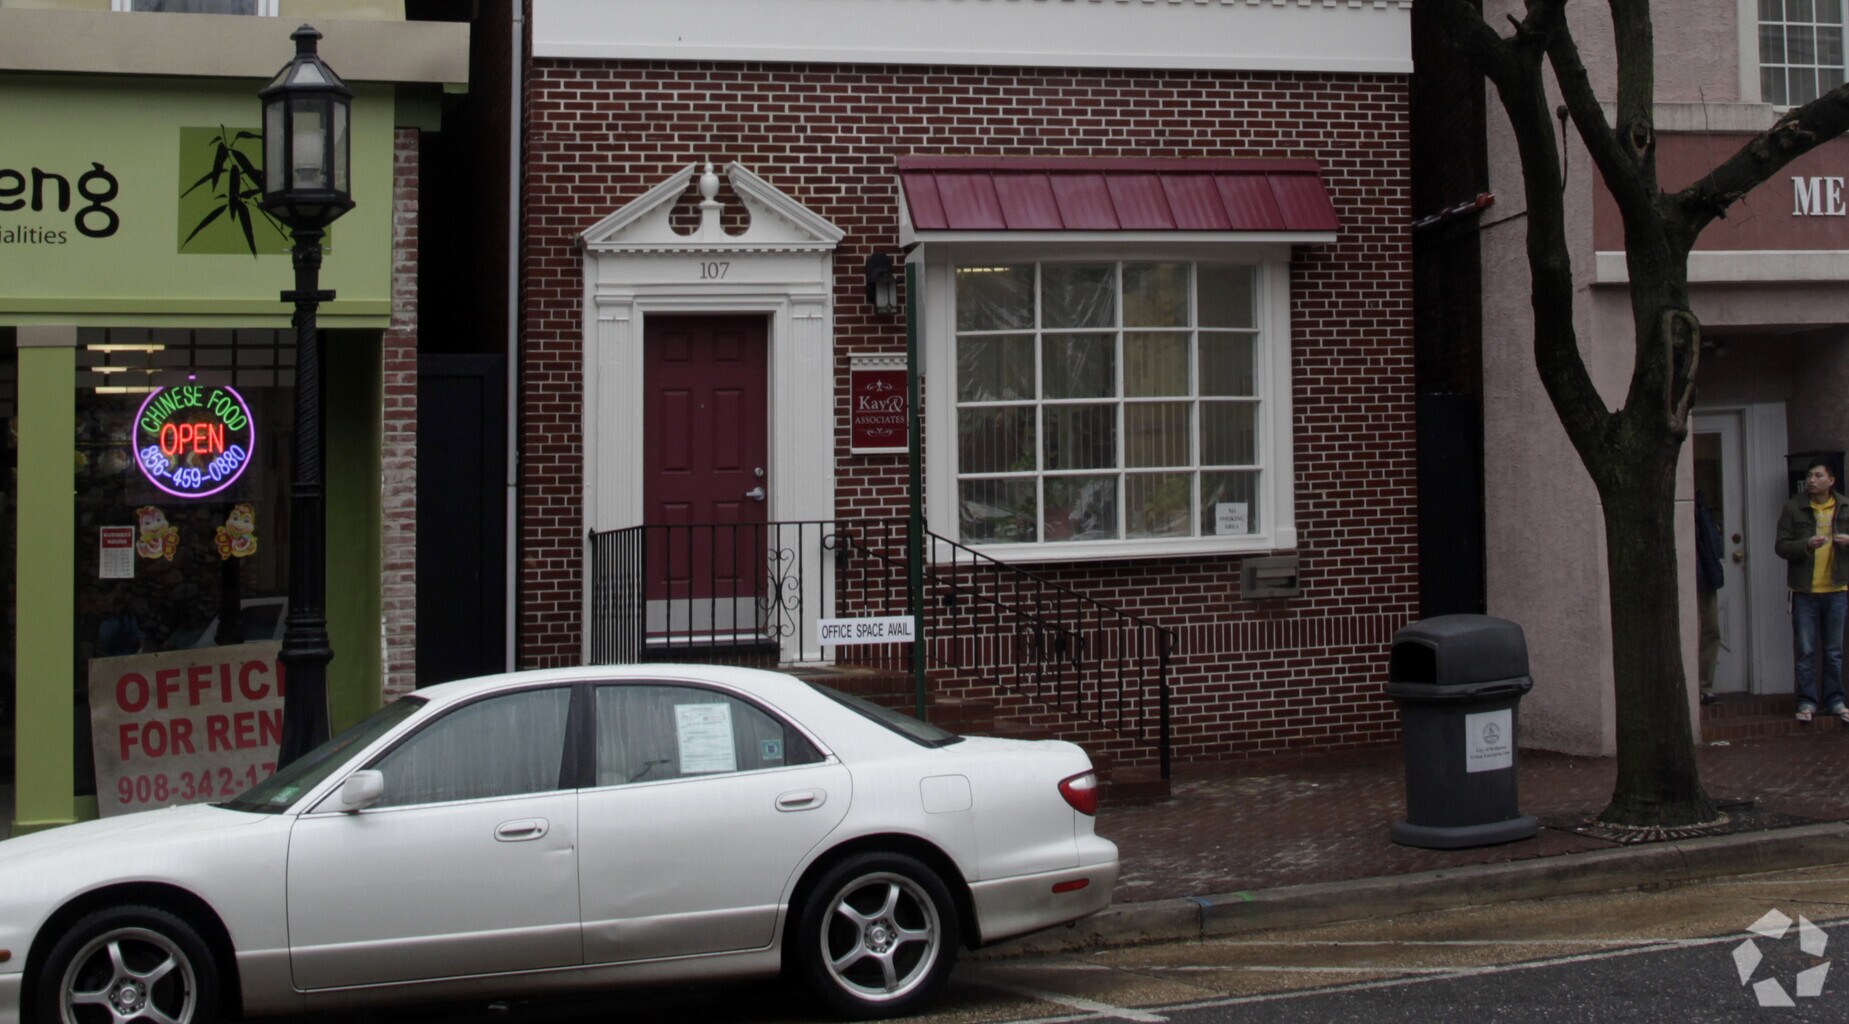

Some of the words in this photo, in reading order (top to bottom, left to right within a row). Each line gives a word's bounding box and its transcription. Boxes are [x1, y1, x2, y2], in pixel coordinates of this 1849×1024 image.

[1791, 176, 1846, 216] ME
[700, 262, 730, 279] 107
[140, 385, 204, 434] CHINESE
[207, 389, 247, 431] FOOD
[855, 416, 905, 425] ASSOCIATES
[858, 395, 888, 412] Kay
[160, 422, 225, 456] OPEN
[140, 444, 246, 489] 856-459-0880
[822, 624, 852, 640] OFFICE
[856, 623, 884, 638] SPACE
[887, 622, 912, 637] AVAIL.
[119, 718, 197, 761] FOR
[206, 708, 284, 753] REN
